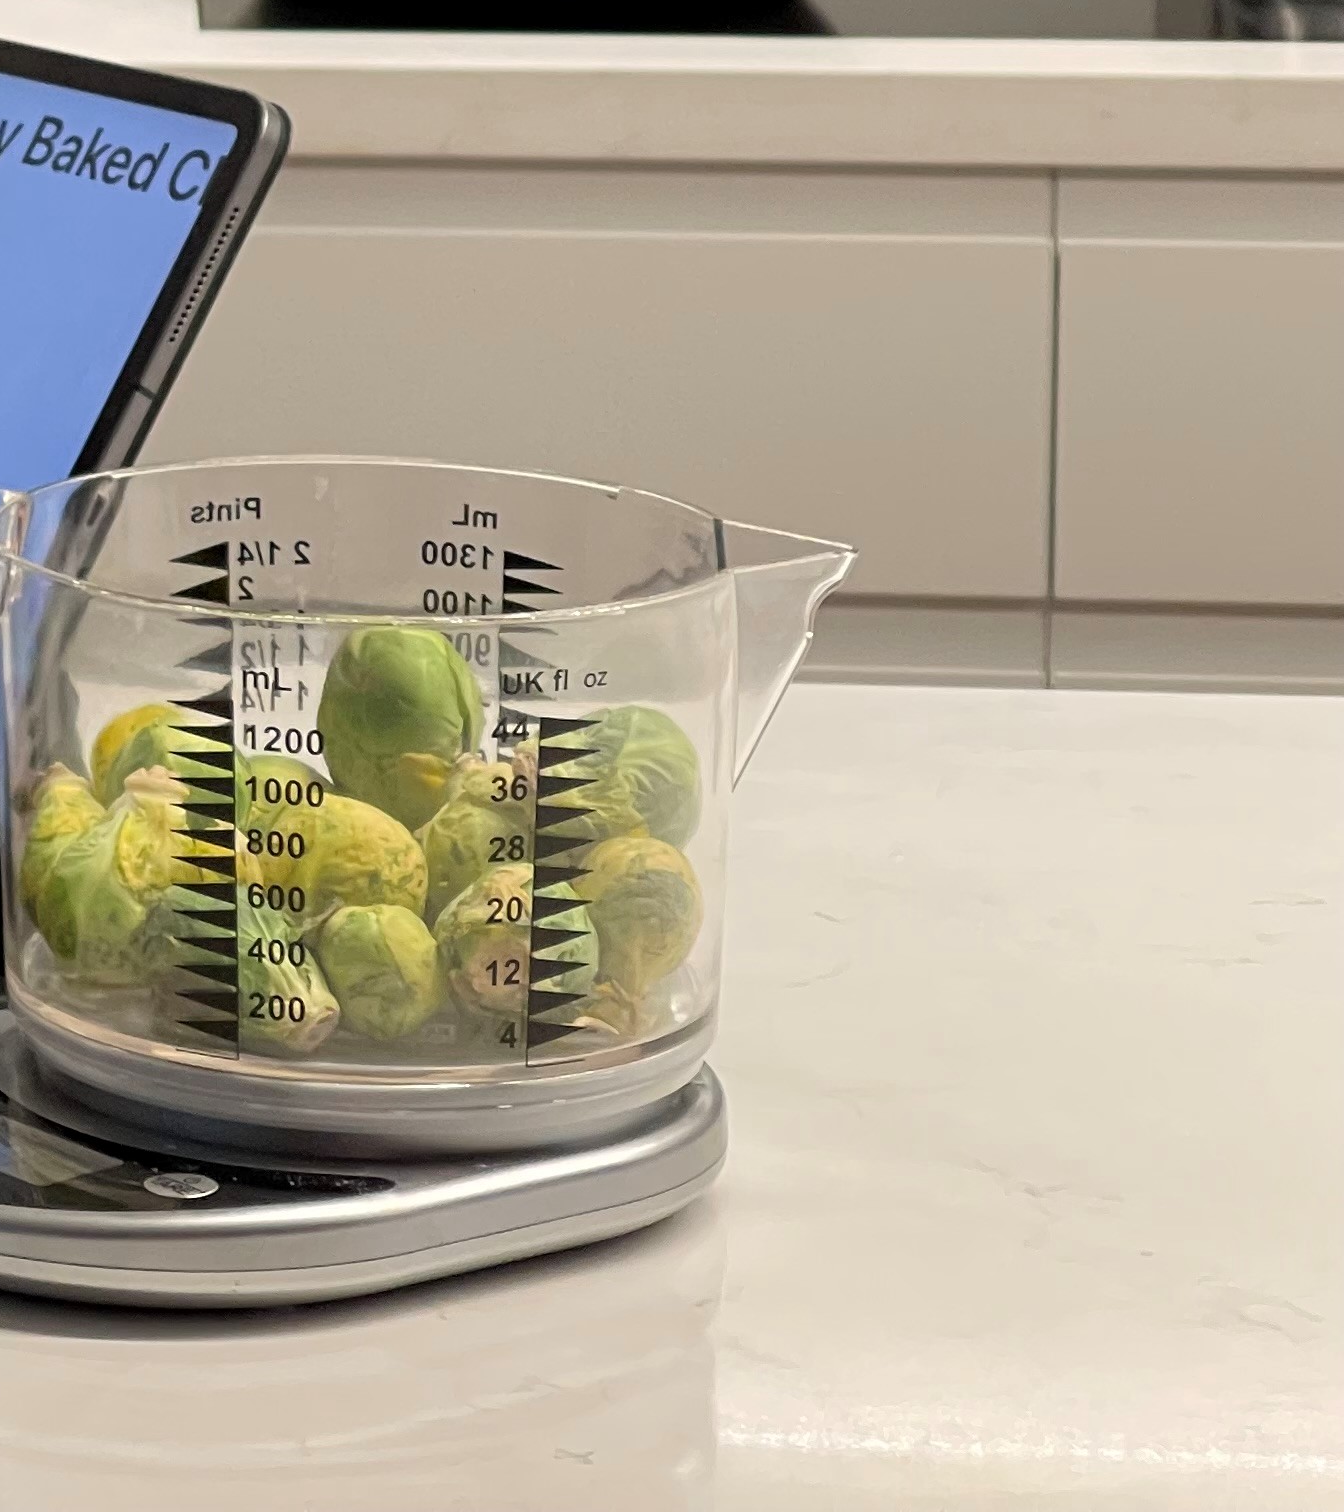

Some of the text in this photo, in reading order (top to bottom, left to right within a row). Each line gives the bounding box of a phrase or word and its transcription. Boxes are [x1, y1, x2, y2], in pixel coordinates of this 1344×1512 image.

[22, 115, 171, 194] Baked
[169, 149, 226, 207] C
[502, 668, 608, 696] UK fl oz
[491, 717, 531, 743] 44
[244, 774, 325, 809] 1000
[490, 774, 529, 803] 36
[246, 827, 307, 860] 800
[487, 834, 526, 864] 28
[247, 881, 307, 914] 600
[485, 896, 524, 925] 20
[247, 937, 307, 969] 400
[484, 958, 521, 987] 12
[248, 992, 307, 1024] 200
[498, 1021, 517, 1049] 4
